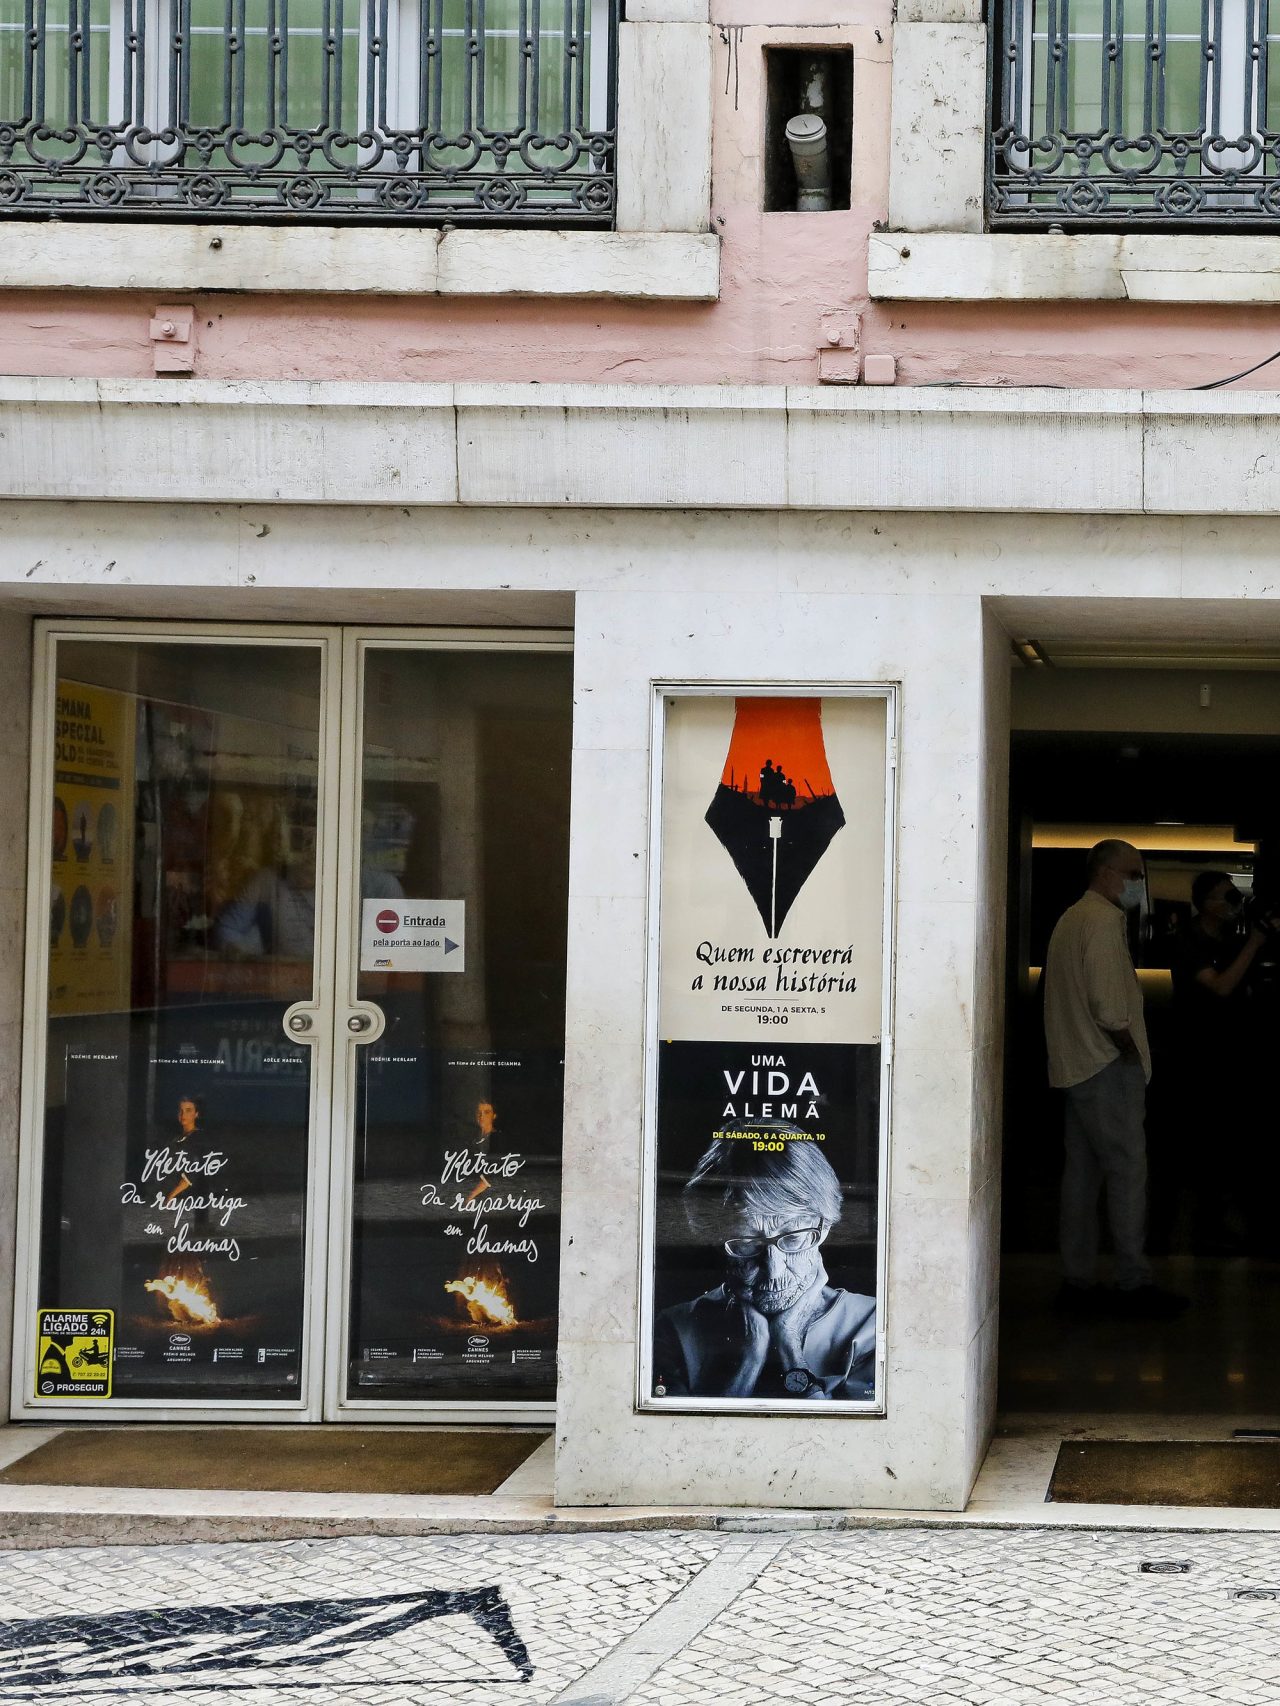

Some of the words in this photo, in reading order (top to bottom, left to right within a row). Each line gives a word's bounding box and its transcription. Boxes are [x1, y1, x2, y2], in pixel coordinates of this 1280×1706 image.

[56, 697, 92, 720] EMANA
[403, 915, 446, 927] Entrada
[373, 938, 389, 947] pela
[390, 938, 411, 947] porta
[423, 938, 440, 946] lado
[696, 940, 755, 966] Quem
[762, 944, 854, 964] escreverá
[691, 974, 703, 990] a
[713, 975, 767, 991] nossa
[775, 963, 857, 992] história
[756, 1014, 789, 1025] 19:00
[751, 1054, 787, 1067] UMA
[723, 1070, 821, 1097] VIDA
[722, 1100, 820, 1119] ALEMÃ
[712, 1131, 724, 1139] DE
[725, 1130, 762, 1140] SÁBADO,
[770, 1132, 777, 1140] A
[778, 1132, 815, 1141] QUARTA,
[816, 1133, 826, 1141] 10
[752, 1141, 785, 1152] 19:00
[141, 1147, 229, 1183] Retrato
[441, 1148, 527, 1184] Retrato
[119, 1182, 146, 1204] da
[150, 1188, 248, 1229] rapariga
[420, 1184, 446, 1206] da
[449, 1189, 546, 1230] rapariga
[143, 1223, 164, 1236] em
[167, 1222, 240, 1262] chamas
[443, 1224, 464, 1237] em
[466, 1223, 538, 1263] chamas
[43, 1322, 88, 1332] LIGADO
[44, 1314, 89, 1323] ALARME
[56, 1384, 104, 1392] PROSEGUR
